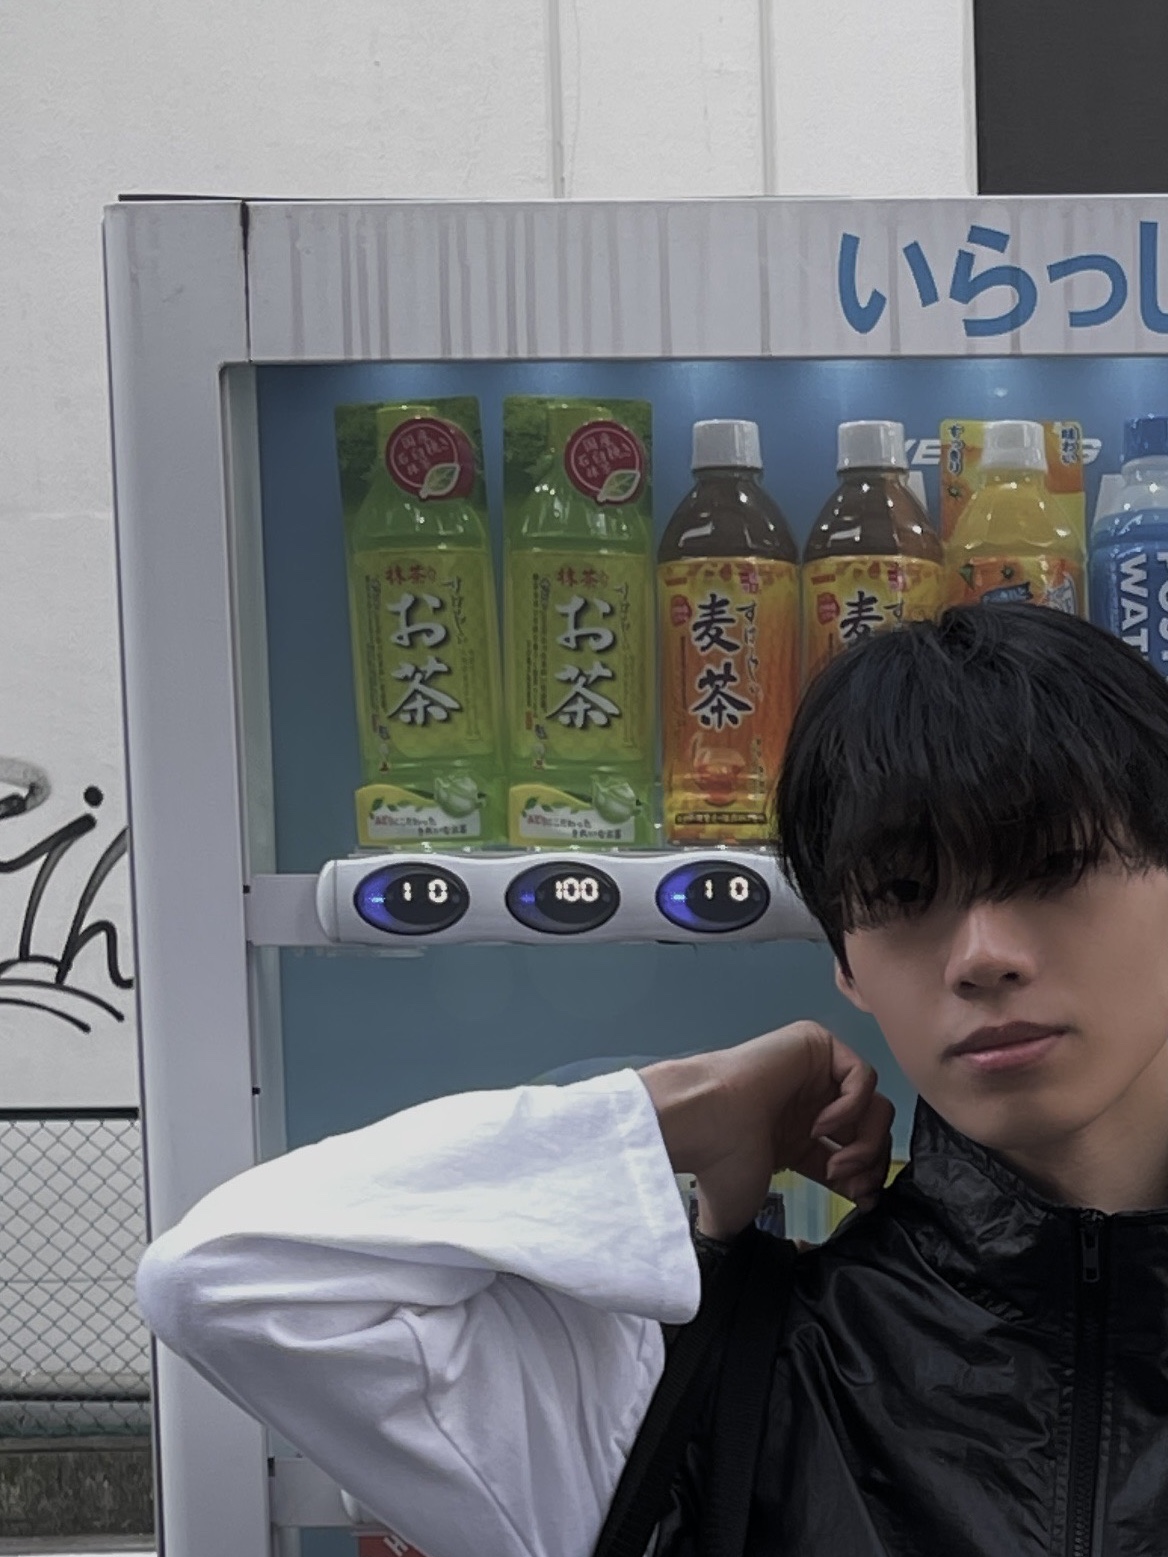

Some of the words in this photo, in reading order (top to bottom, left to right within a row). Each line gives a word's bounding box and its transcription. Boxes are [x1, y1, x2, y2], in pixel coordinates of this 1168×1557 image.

[388, 593, 463, 726] お茶
[546, 595, 622, 729] お茶
[691, 592, 754, 730] 麦茶
[555, 877, 599, 903] 100
